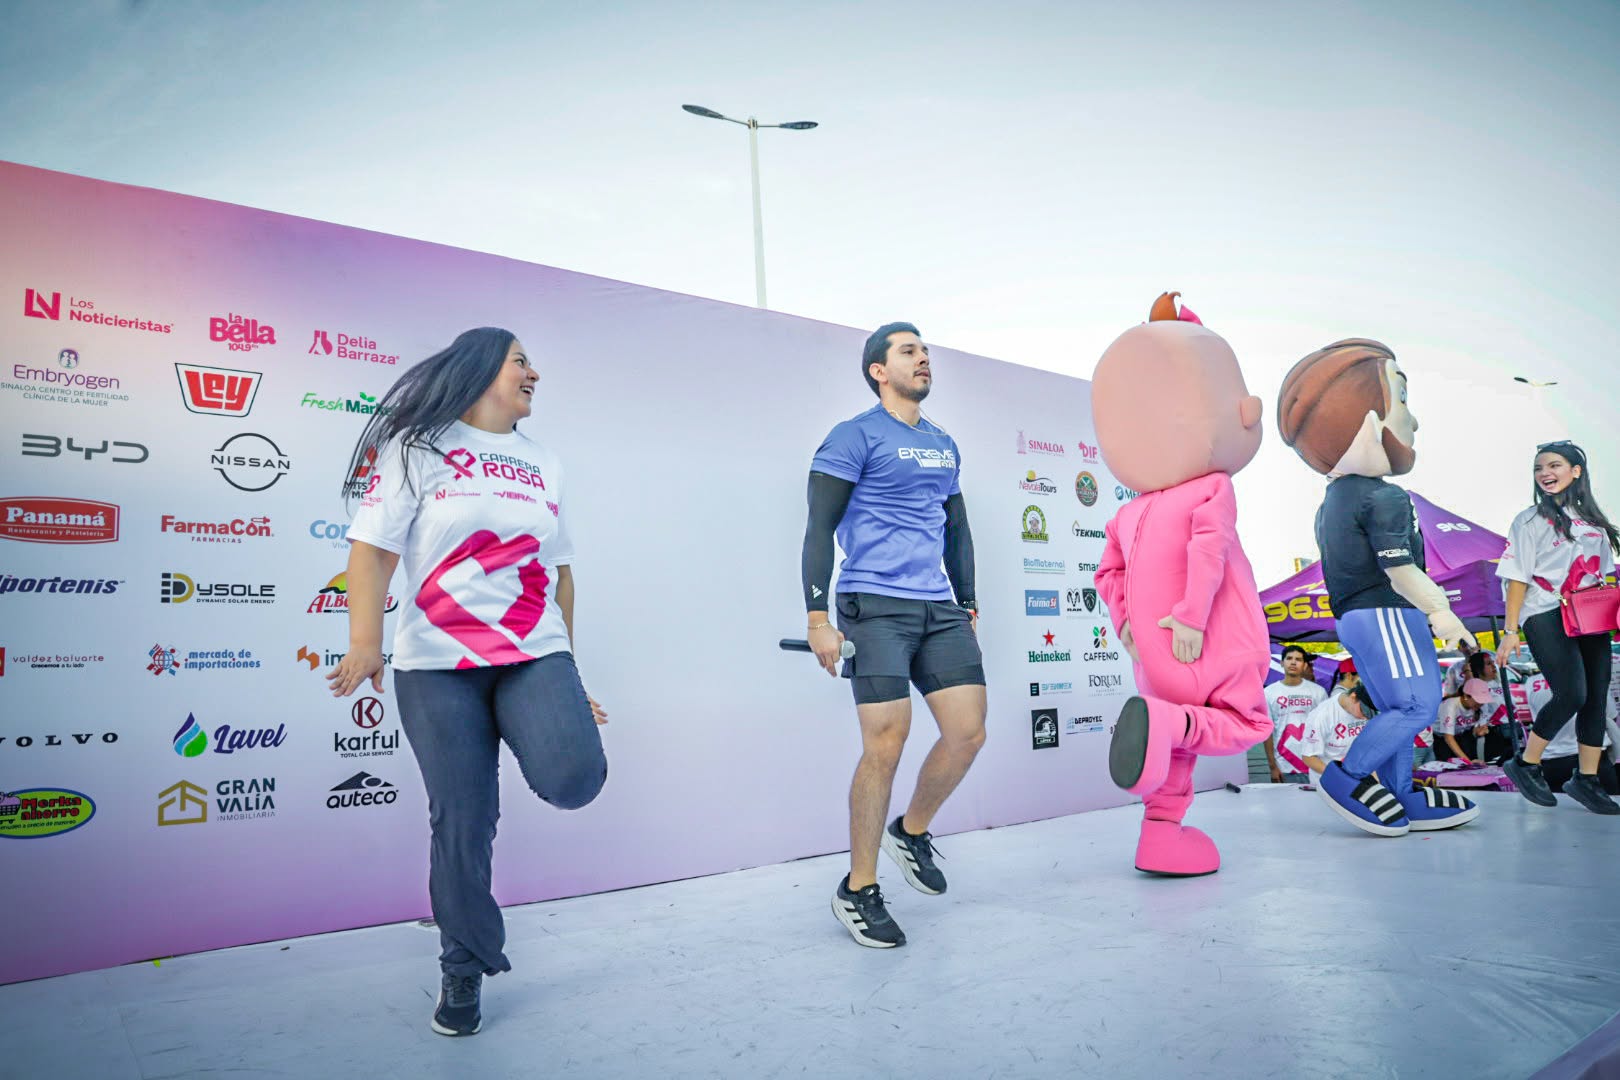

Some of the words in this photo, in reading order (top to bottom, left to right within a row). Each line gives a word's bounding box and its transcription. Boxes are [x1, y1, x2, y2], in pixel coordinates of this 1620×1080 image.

[69, 296, 95, 310] Los
[69, 309, 173, 334] Noticieristas
[209, 316, 277, 345] Bella
[336, 332, 378, 350] Delia
[336, 346, 397, 365] Barraza
[13, 364, 121, 390] Embryogen
[0, 382, 37, 392] SINALOA
[38, 386, 72, 396] CENTRO
[86, 391, 130, 401] FERTILIDAD
[82, 398, 109, 407] MUJER
[300, 392, 344, 411] Fresh
[21, 433, 150, 464] BYD
[897, 447, 955, 461] EXTREME
[1028, 439, 1065, 454] SINALOA
[1082, 445, 1098, 459] DIF
[211, 454, 291, 470] NISSAN
[479, 452, 541, 475] CARRERA
[482, 462, 546, 491] ROSA
[5, 505, 106, 527] Panamá
[191, 536, 243, 544] FARMACIAS
[12, 654, 53, 664] valdez
[55, 654, 105, 664] baluarte
[189, 649, 235, 660] mercado
[237, 649, 251, 660] de
[1028, 650, 1072, 663] Heineken
[1083, 651, 1119, 662] CAFFENIO
[184, 657, 261, 672] importaciones
[1088, 674, 1122, 689] FORUM
[0, 732, 119, 748] OLVO
[213, 722, 288, 755] Lavel
[334, 729, 399, 752] karful
[371, 750, 394, 758] SERVICE
[216, 777, 276, 796] GRAN
[326, 788, 397, 809] auteco
[21, 807, 80, 821] ahorro
[216, 811, 276, 822] INMOBILIARIA
